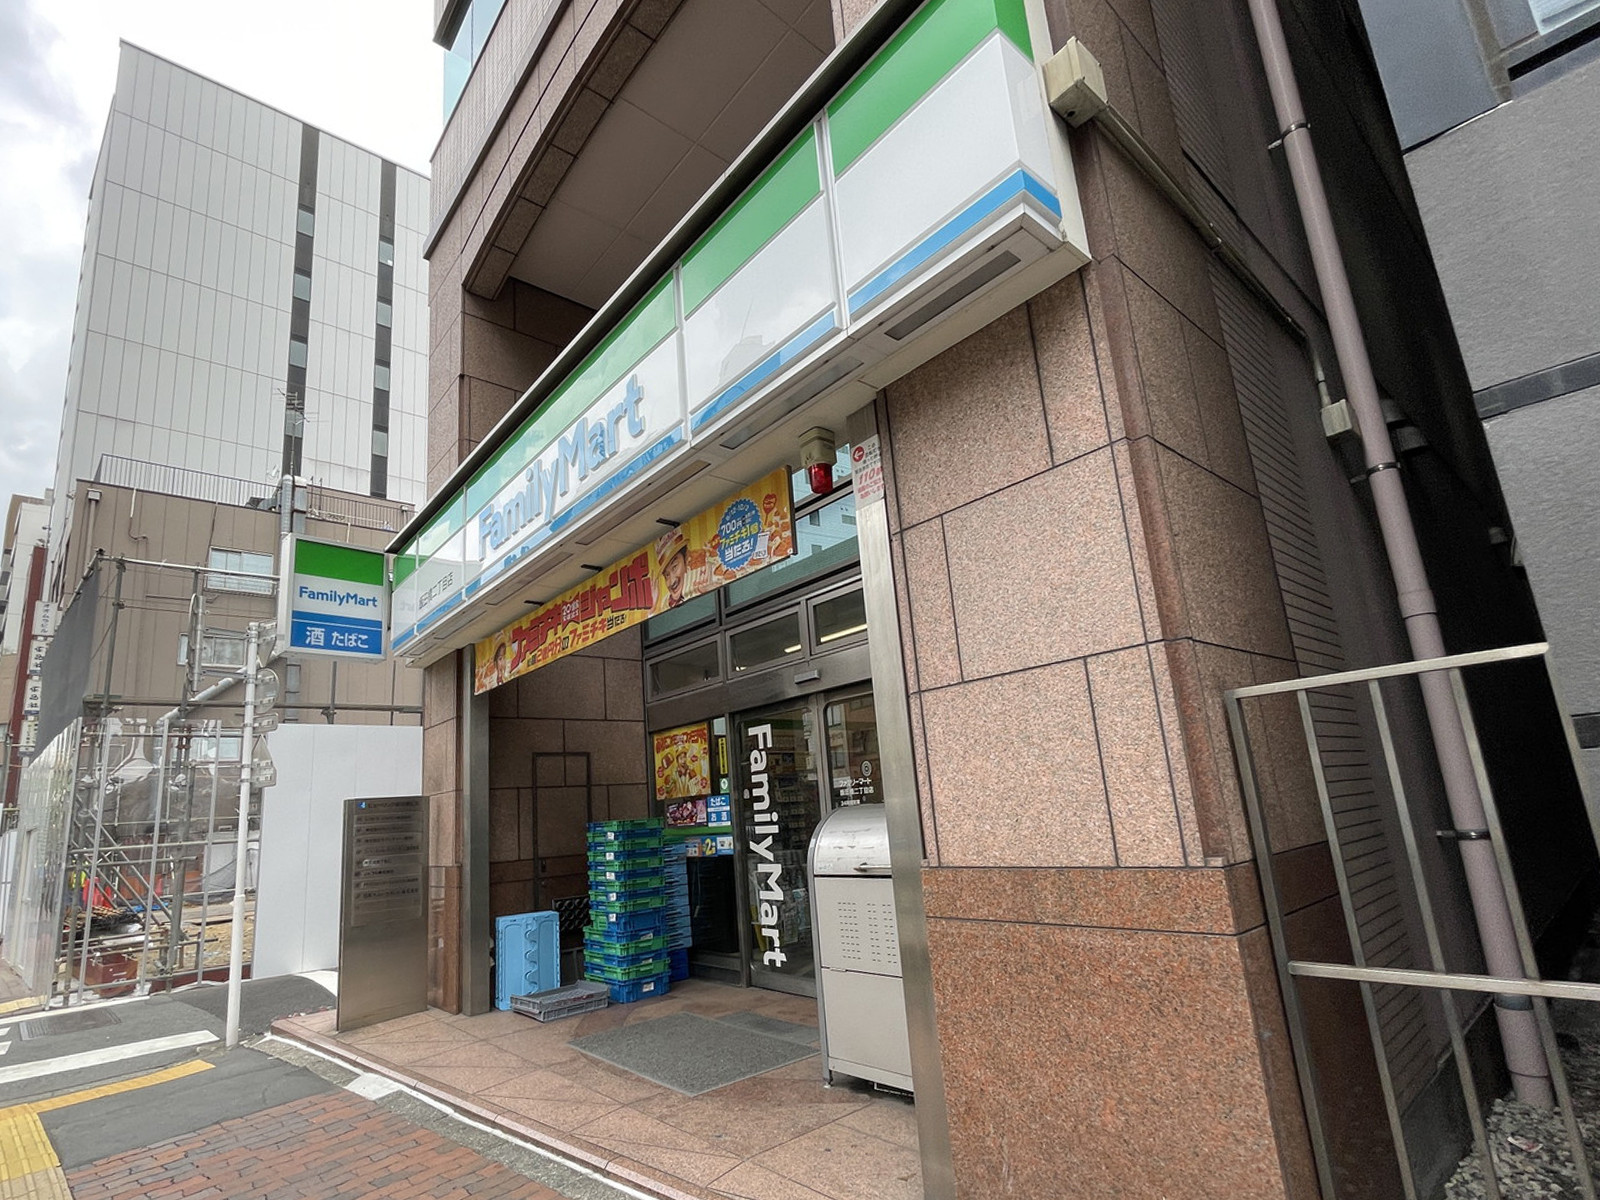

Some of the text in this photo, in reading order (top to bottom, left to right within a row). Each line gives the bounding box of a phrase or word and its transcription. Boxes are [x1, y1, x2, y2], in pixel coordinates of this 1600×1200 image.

[479, 373, 645, 562] FamilyMart
[725, 538, 754, 562] 当たる!
[299, 585, 378, 608] FamilyMart
[305, 626, 369, 648] 酒 たばこ
[710, 796, 727, 806] たばこ
[748, 723, 787, 967] FamilyMart
